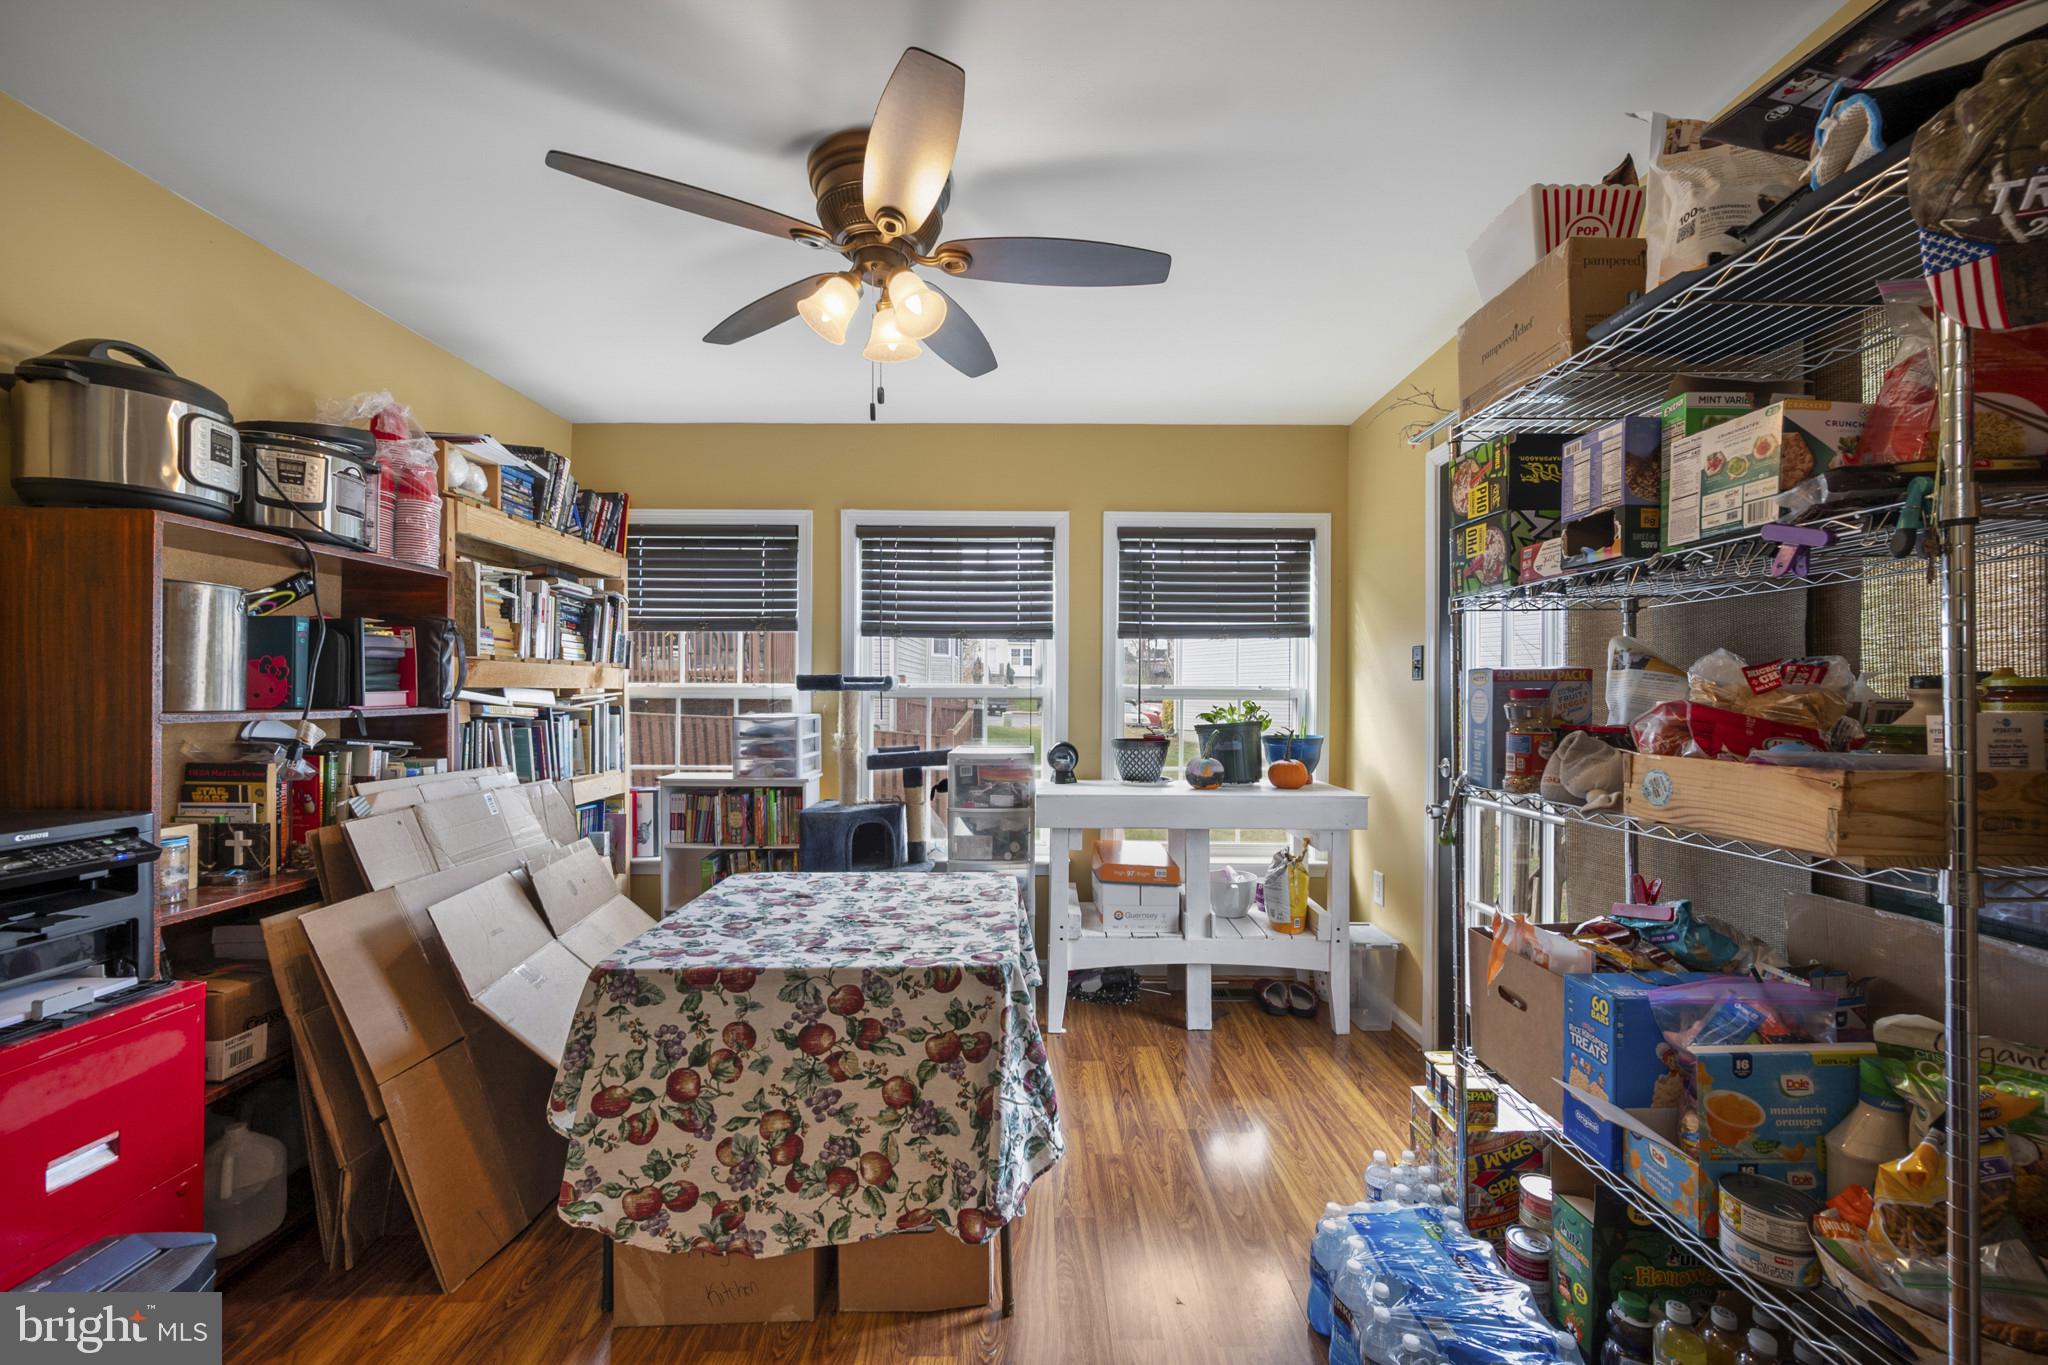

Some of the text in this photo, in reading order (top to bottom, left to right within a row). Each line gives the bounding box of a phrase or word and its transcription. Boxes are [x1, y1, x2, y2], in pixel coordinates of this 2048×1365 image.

[1576, 226, 1600, 236] POP
[1584, 252, 1641, 269] pampered
[1481, 330, 1515, 366] pampered
[1517, 315, 1535, 337] chef
[1698, 395, 1722, 405] MINT
[1475, 485, 1487, 514] PHO
[1467, 528, 1478, 557] PHO
[1513, 671, 1553, 681] FAMILY
[1556, 671, 1588, 681] PACK
[1558, 692, 1582, 703] FRUIT
[194, 786, 227, 795] STAR
[191, 793, 230, 802] WARS
[15, 832, 49, 842] Canon
[1125, 911, 1159, 921] Guernsey
[1591, 995, 1609, 1016] 60
[1591, 1010, 1609, 1026] BARS
[1569, 1032, 1608, 1065] TREATS
[1735, 1059, 1750, 1069] 16
[1785, 1078, 1809, 1089] Dole
[1466, 1090, 1496, 1102] SPAM
[1770, 1106, 1827, 1116] mandarin
[1775, 1118, 1823, 1128] oranges
[1482, 1137, 1534, 1169] SPAM
[1791, 1175, 1813, 1185] Dole
[704, 1279, 760, 1307] Kitchen
